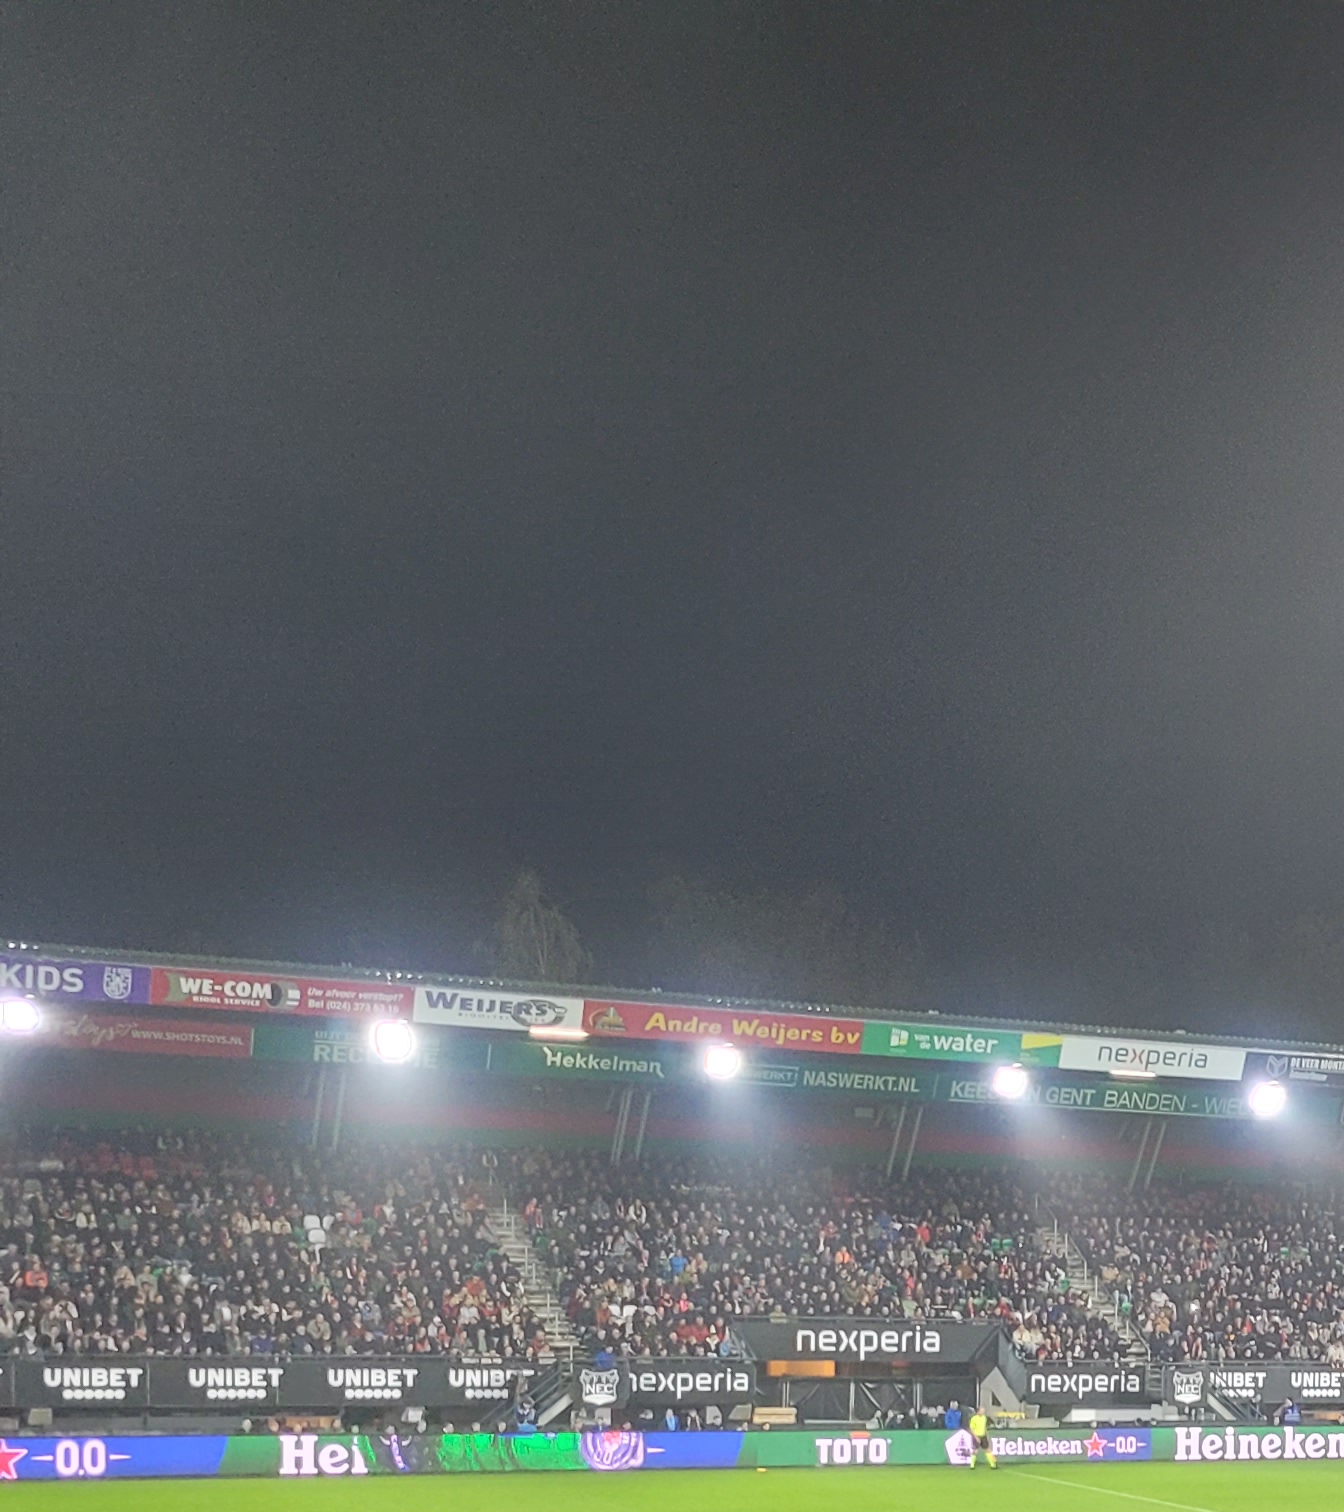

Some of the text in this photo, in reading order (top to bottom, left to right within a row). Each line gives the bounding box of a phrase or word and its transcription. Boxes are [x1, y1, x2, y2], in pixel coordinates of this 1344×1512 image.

[0, 963, 84, 993] KIDS
[179, 976, 272, 999] WE-COM
[425, 990, 549, 1017] WEIJERS
[645, 1012, 861, 1045] Andre Weijers bv
[933, 1032, 999, 1055] water
[543, 1047, 665, 1078] Hekkelman
[1098, 1044, 1208, 1071] nexperia
[803, 1070, 920, 1094] NASWERKT.NL
[1046, 1089, 1095, 1107] GENT
[1103, 1090, 1186, 1113] BANDEN
[797, 1325, 940, 1361] nexperia
[43, 1367, 534, 1388] UNIBET UNIBET UNIBET UNIB
[586, 1383, 614, 1394] NEC
[1031, 1370, 1140, 1399] nexperia
[1177, 1384, 1199, 1394] NEC
[816, 1438, 888, 1464] TOTO
[991, 1437, 1083, 1457] Heineken
